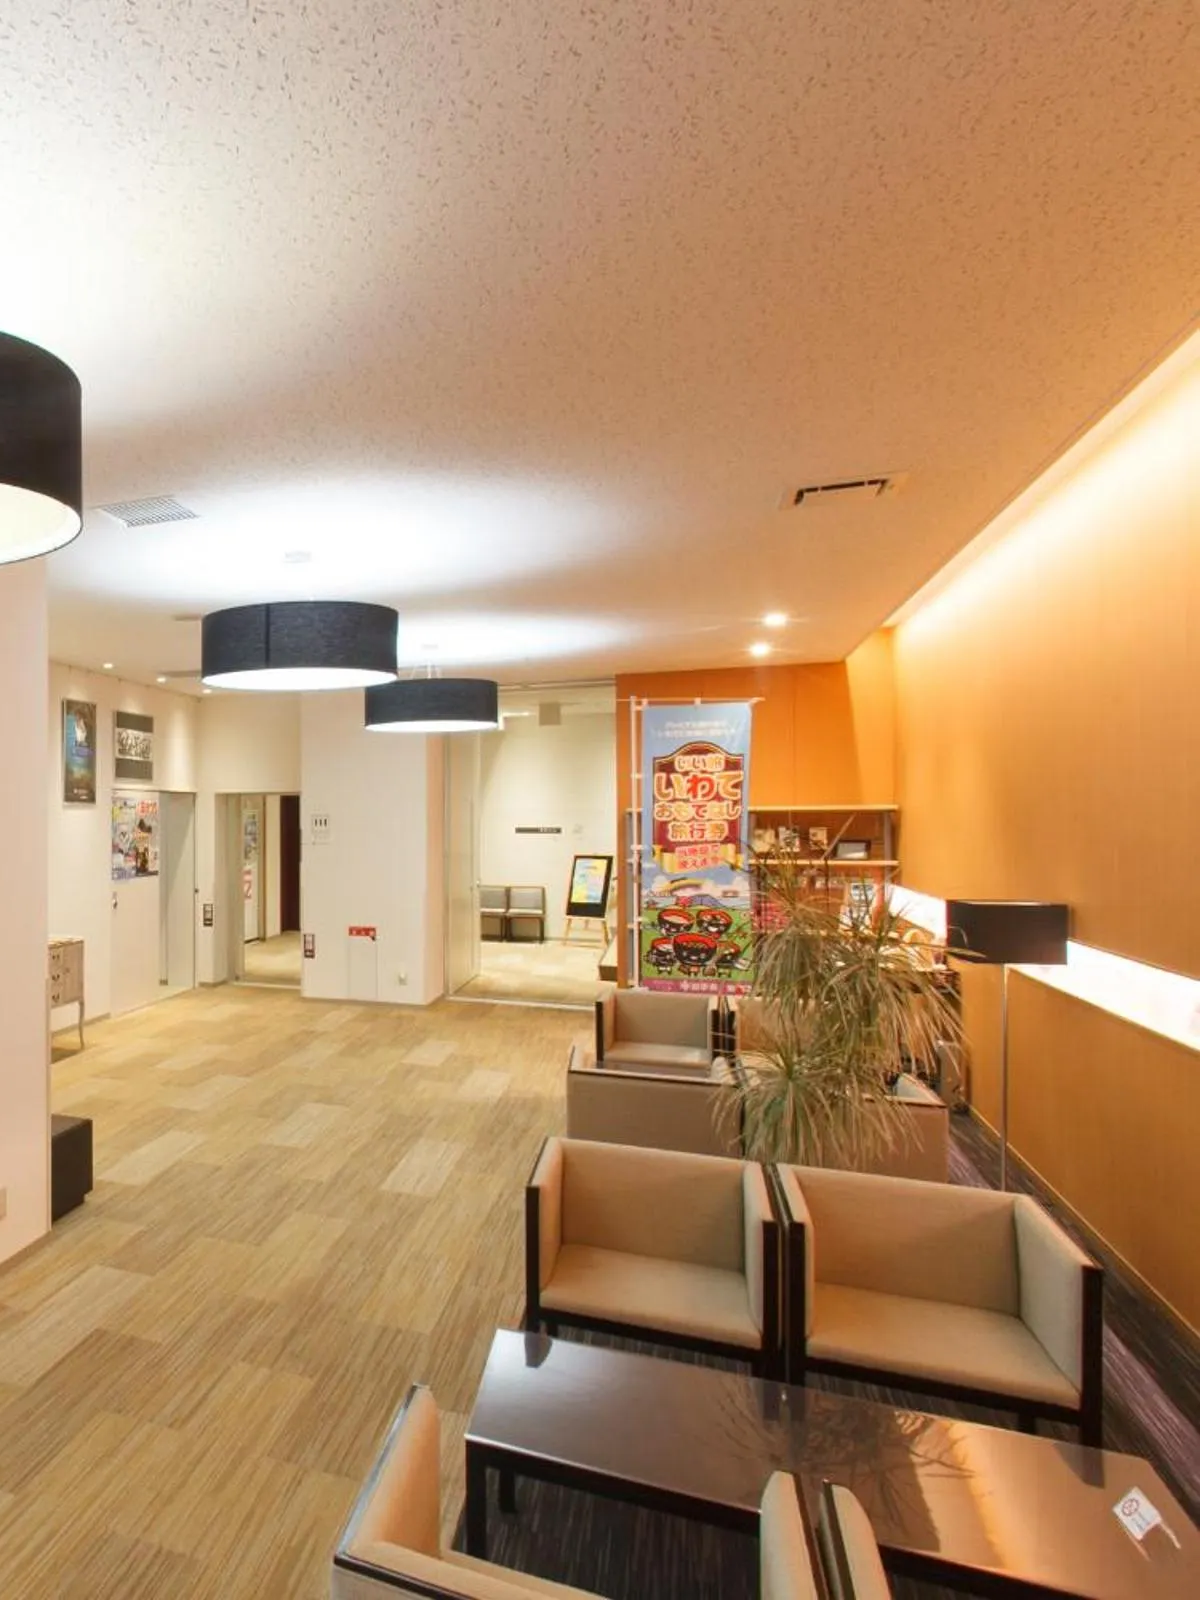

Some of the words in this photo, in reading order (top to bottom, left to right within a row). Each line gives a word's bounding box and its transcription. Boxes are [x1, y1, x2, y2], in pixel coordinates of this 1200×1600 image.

[655, 770, 744, 801] いわて
[655, 801, 742, 821] おもてなし
[668, 821, 729, 842] 旅行券
